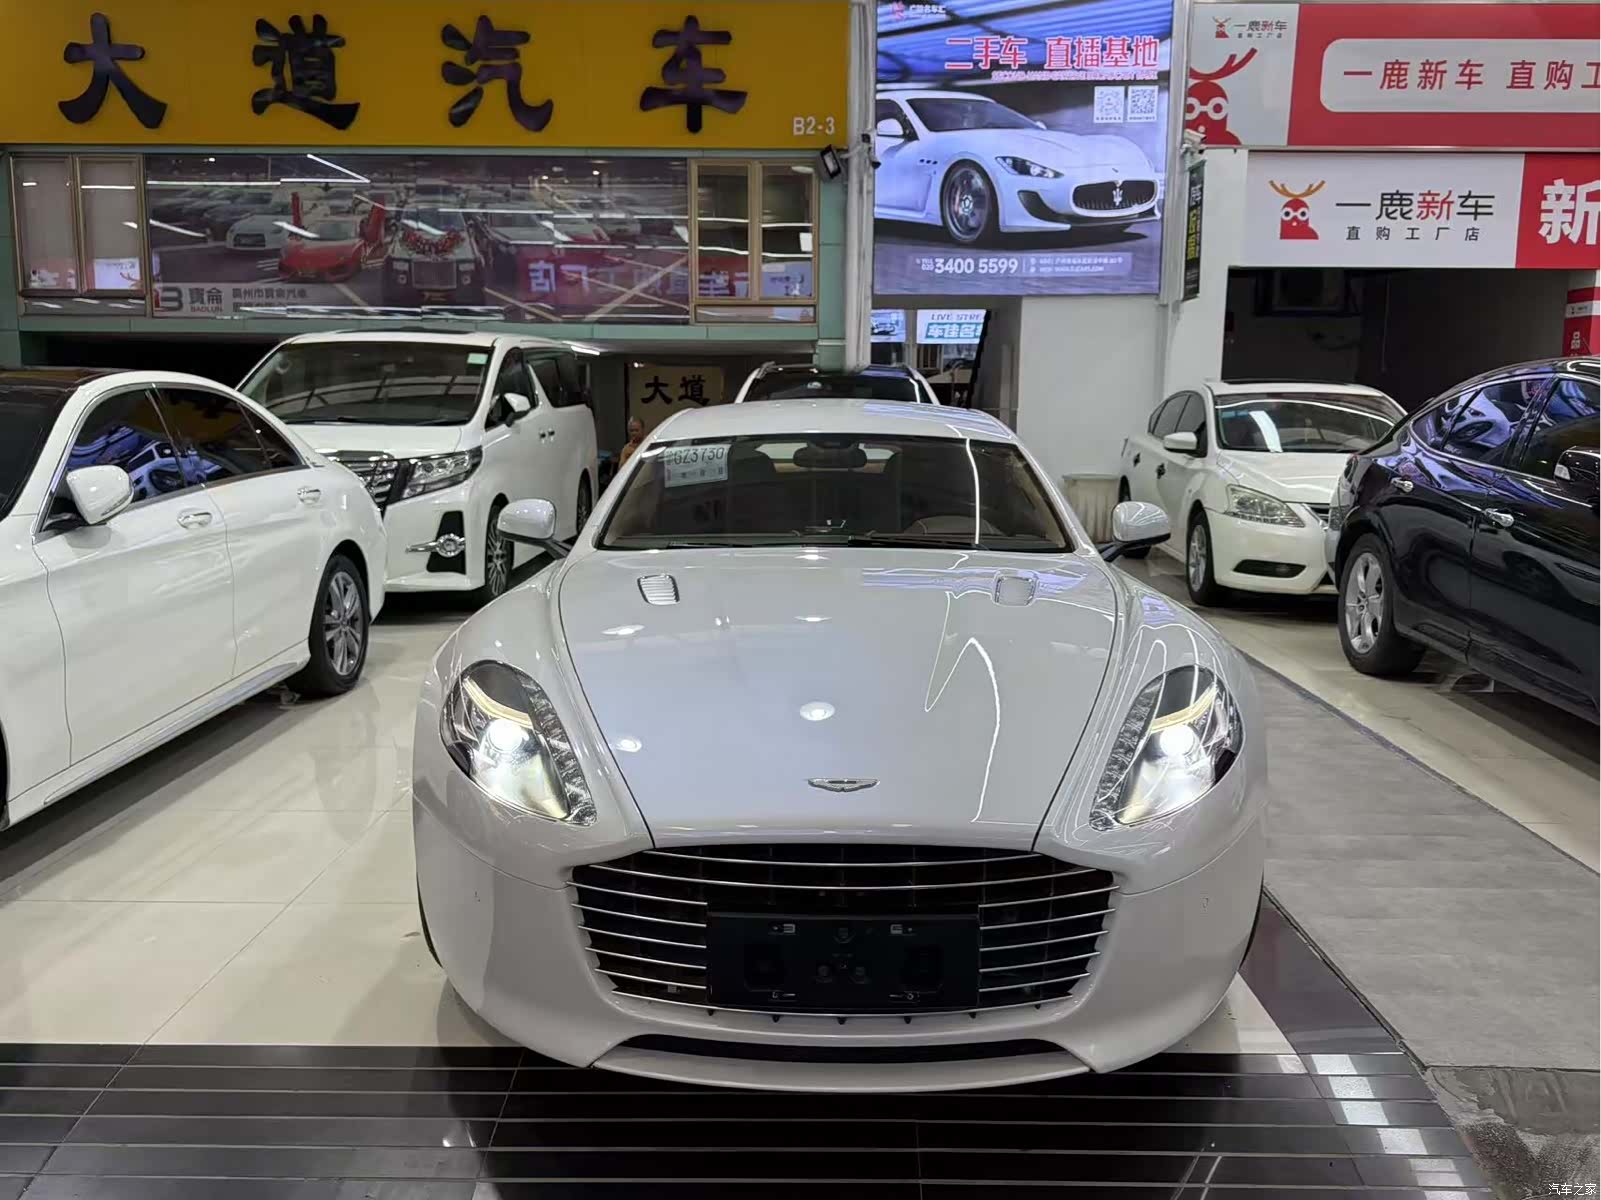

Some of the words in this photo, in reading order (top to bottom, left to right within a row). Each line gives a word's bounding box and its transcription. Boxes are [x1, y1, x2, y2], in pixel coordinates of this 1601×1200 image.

[1233, 20, 1288, 31] 一鹿新车
[945, 35, 1028, 70] 二手车
[1044, 35, 1160, 70] 直播基地
[58, 13, 747, 133] 大道汽车
[1343, 59, 1485, 91] 一鹿新车
[793, 116, 835, 135] B2-3
[1335, 189, 1496, 222] 一鹿新车
[1537, 178, 1600, 245] 新
[1346, 226, 1481, 242] 直购工厂店
[935, 258, 975, 274] 3400
[978, 258, 1019, 274] 5599
[641, 374, 711, 407] 大道
